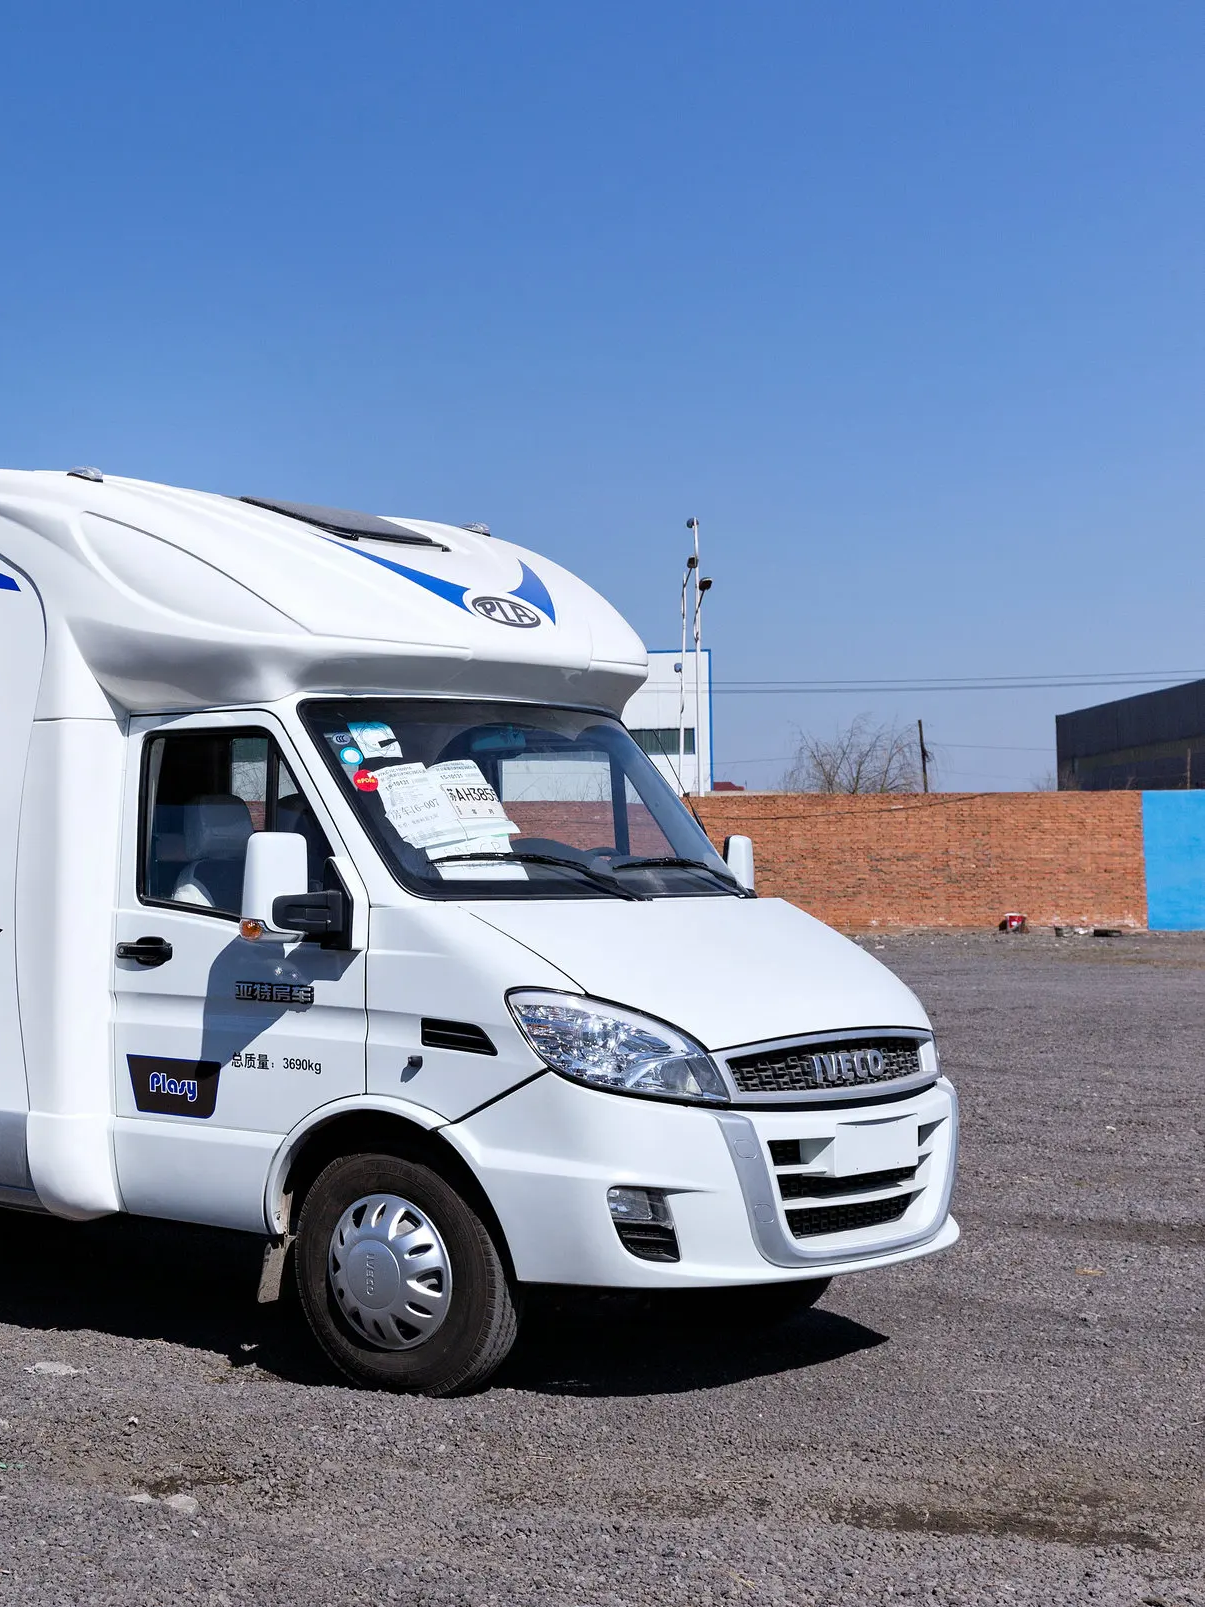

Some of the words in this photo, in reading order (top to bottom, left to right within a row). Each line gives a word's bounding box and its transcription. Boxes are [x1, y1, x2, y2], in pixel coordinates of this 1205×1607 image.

[477, 601, 536, 623] PLA
[235, 982, 314, 1004] 亚特房车
[282, 1057, 322, 1075] 3690kg
[812, 1049, 884, 1083] IVECO
[149, 1071, 197, 1102] Plasy
[365, 1252, 375, 1296] IVECO
